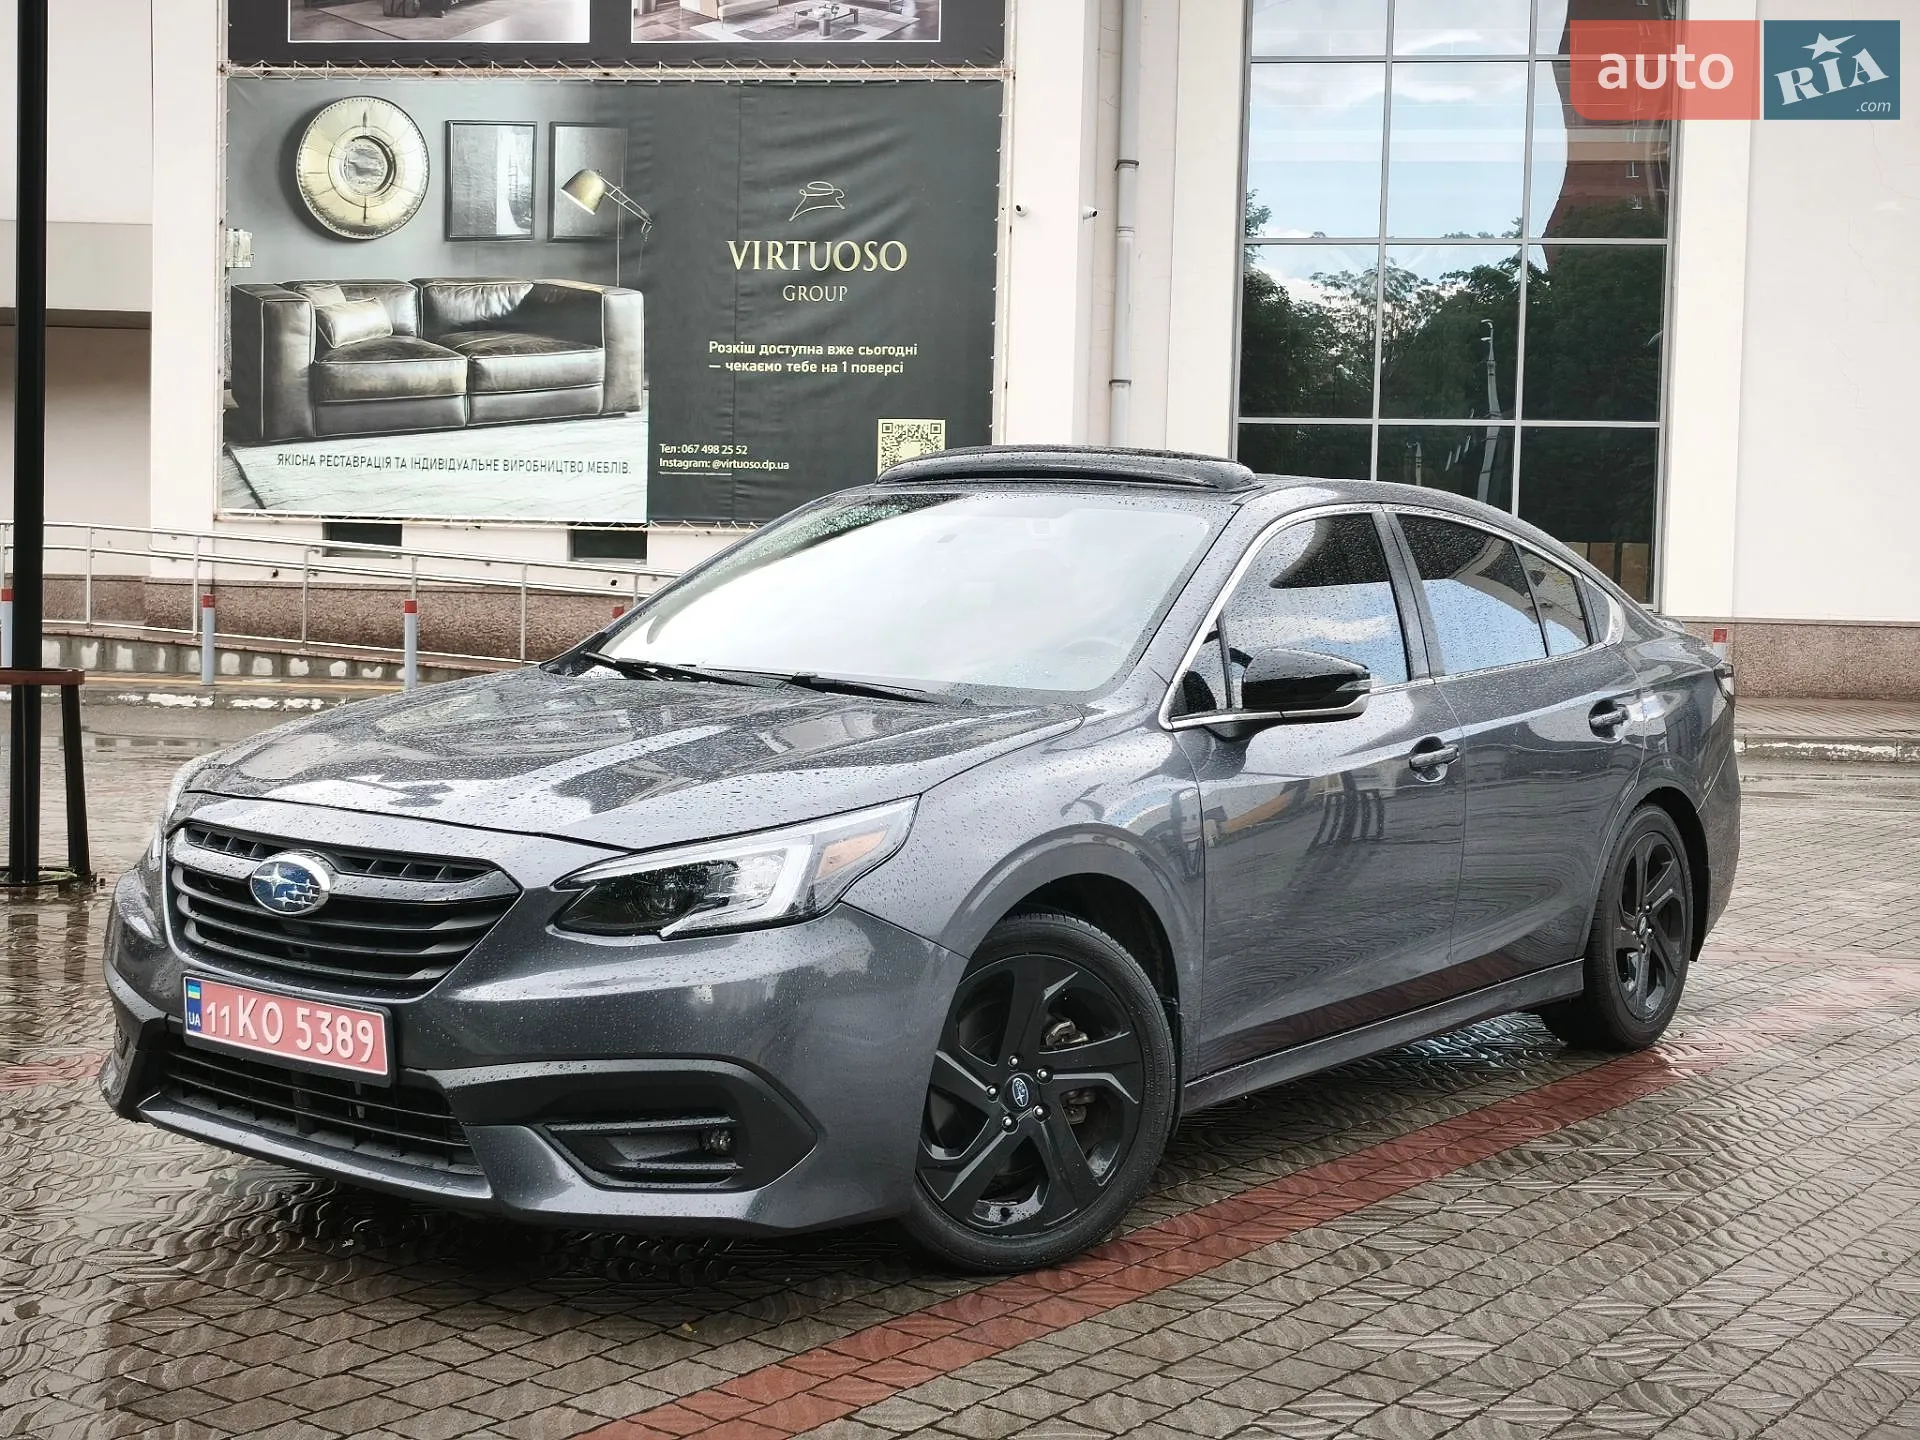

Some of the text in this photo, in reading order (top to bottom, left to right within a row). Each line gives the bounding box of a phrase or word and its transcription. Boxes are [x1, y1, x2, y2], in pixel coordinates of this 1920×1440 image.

[727, 240, 908, 272] VIRTUOSO
[782, 284, 848, 302] GROUP
[708, 341, 918, 357] Розкіш доступна вже сьогодні
[725, 361, 782, 372] чекаємо
[786, 361, 818, 373] тебе
[821, 363, 838, 373] на
[842, 361, 848, 373] 1
[851, 361, 904, 376] поверсі
[681, 443, 700, 454] 067
[701, 444, 720, 454] 498
[721, 445, 734, 455] 25
[735, 445, 748, 455] 52
[277, 453, 631, 475] ЯКІСНА РЕСТАВРАЦІЯ ТА ІНДИВІДУАЛЬНЕ ВИРОБНИЦТВО МЕБЛІВ.
[659, 457, 790, 472] Instagram: @virtuoso.dp.ua
[188, 1014, 201, 1026] UA
[295, 1006, 375, 1063] 5389
